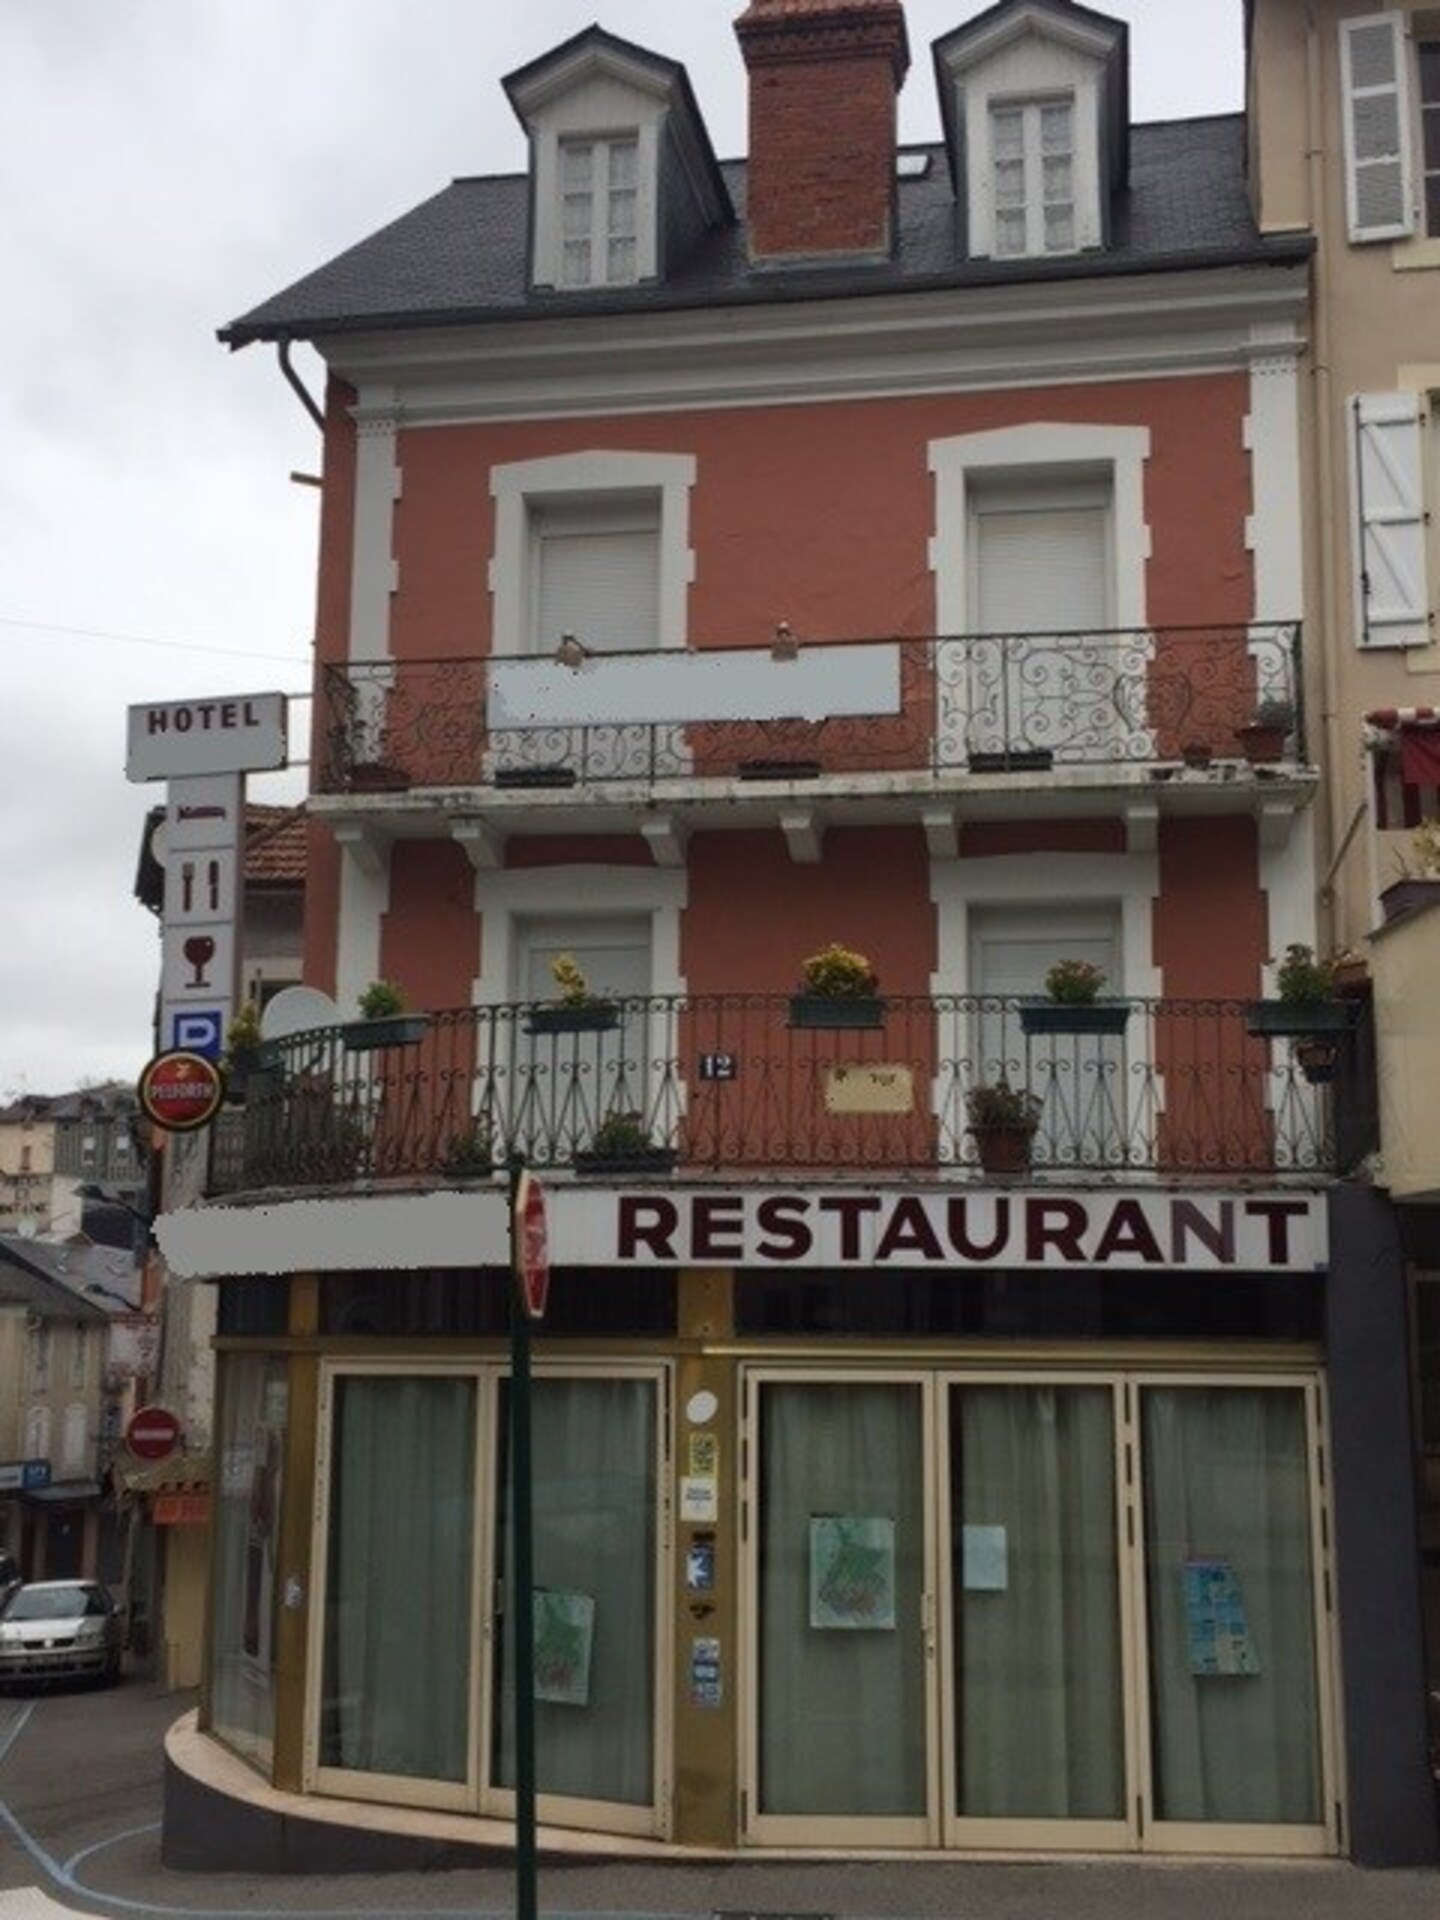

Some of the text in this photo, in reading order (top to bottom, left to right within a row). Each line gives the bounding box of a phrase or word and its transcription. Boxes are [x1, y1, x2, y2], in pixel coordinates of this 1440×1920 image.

[148, 701, 260, 734] HOTEL
[703, 1054, 732, 1077] 12
[616, 1195, 1309, 1266] RESTAURANT
